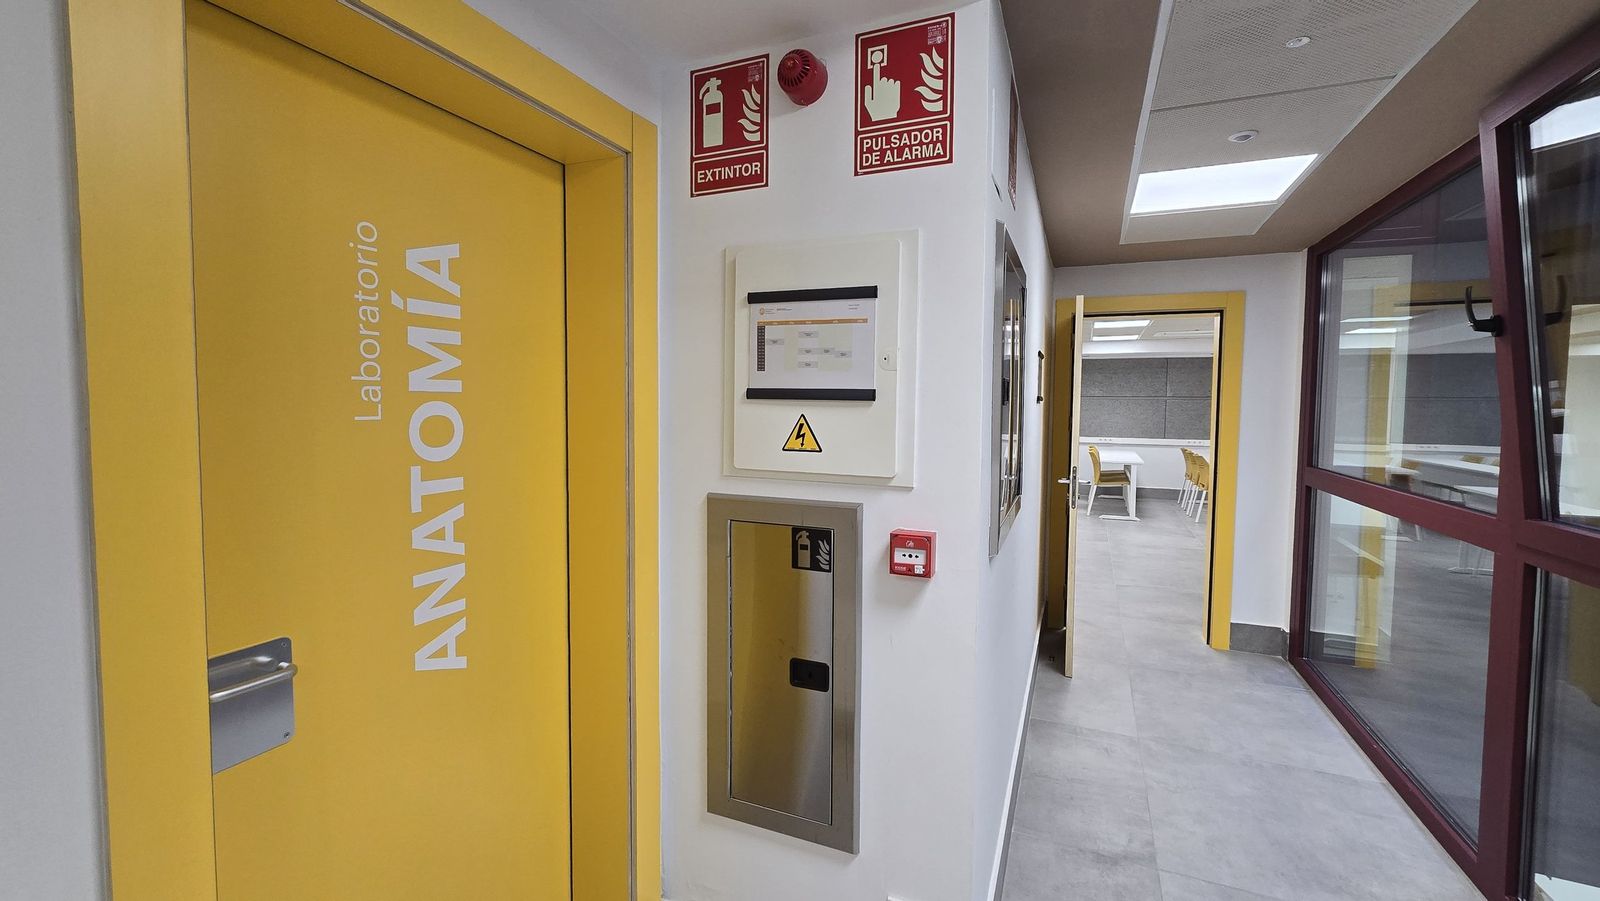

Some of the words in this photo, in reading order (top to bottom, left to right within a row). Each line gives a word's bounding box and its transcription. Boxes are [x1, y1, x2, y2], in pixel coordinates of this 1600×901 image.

[863, 128, 943, 152] PULSADOR
[862, 152, 881, 167] DE
[884, 143, 944, 164] ALARMA
[697, 162, 761, 183] EXTINTOR
[349, 221, 382, 421] Laboratorio
[391, 243, 468, 672] ANATOMÍA
